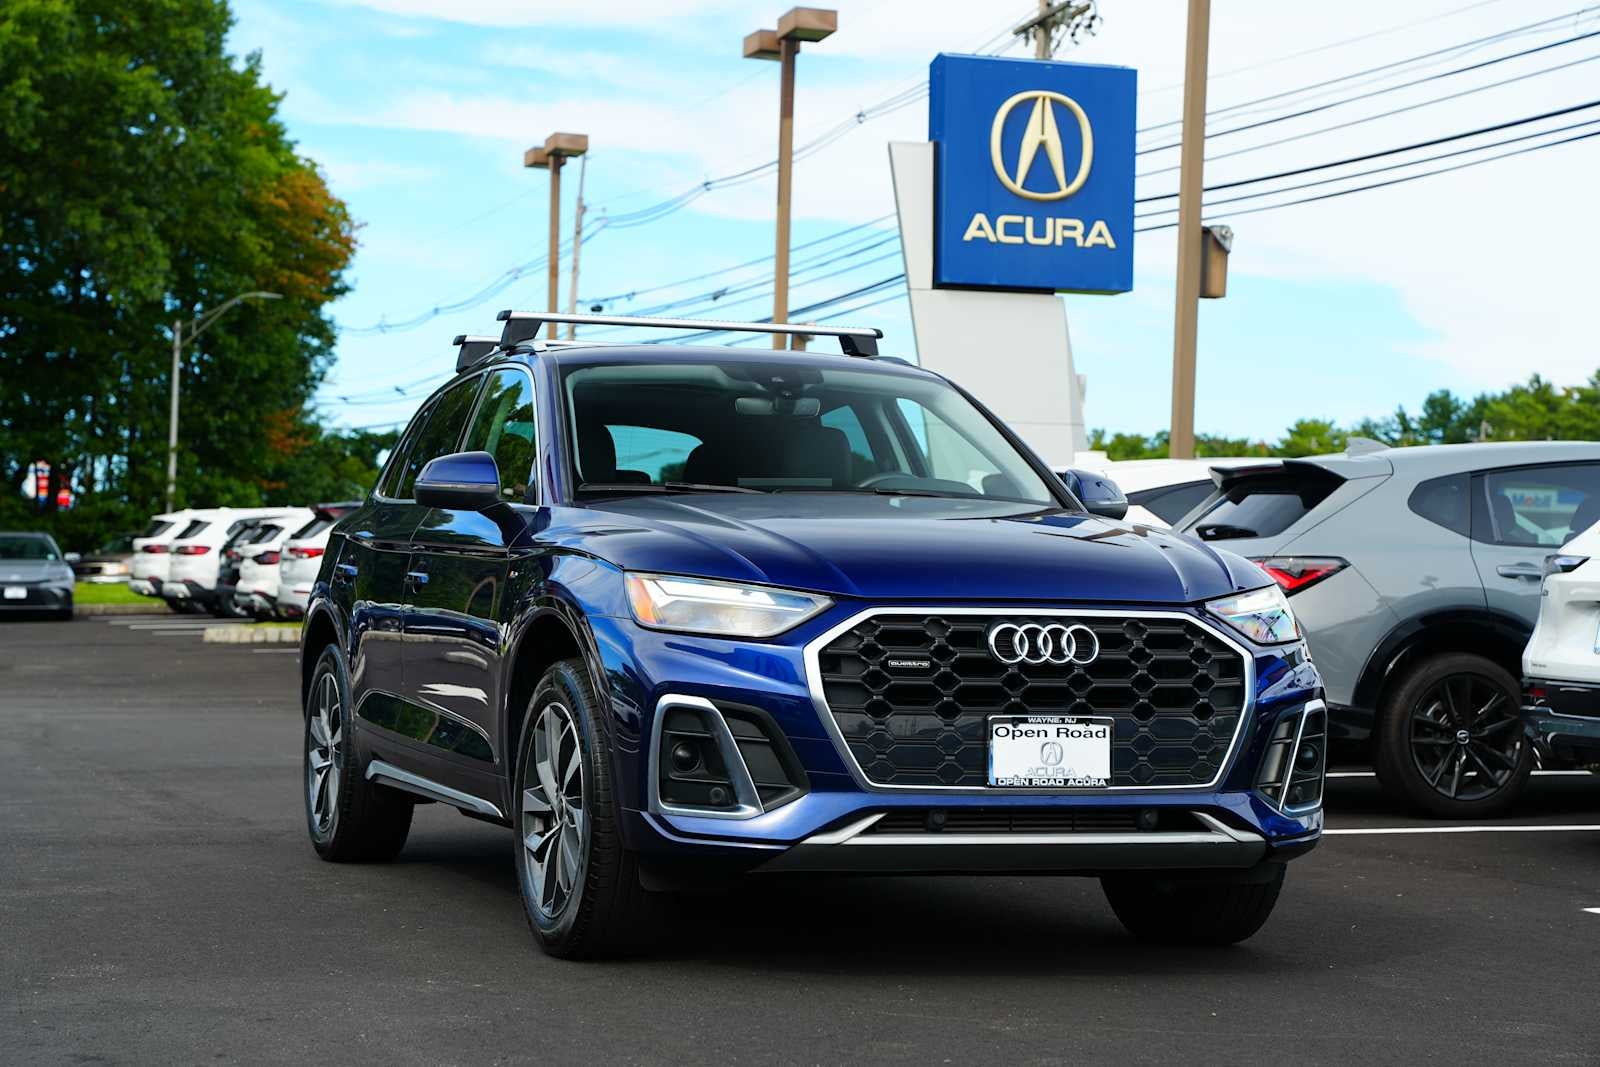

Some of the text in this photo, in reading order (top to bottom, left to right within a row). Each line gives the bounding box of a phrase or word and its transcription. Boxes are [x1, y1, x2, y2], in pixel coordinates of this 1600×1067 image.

[962, 212, 1116, 249] ACURA
[994, 726, 1107, 740] Open Road
[1025, 767, 1077, 777] ACURA
[998, 778, 1106, 786] OPEN ROAD ACURA
